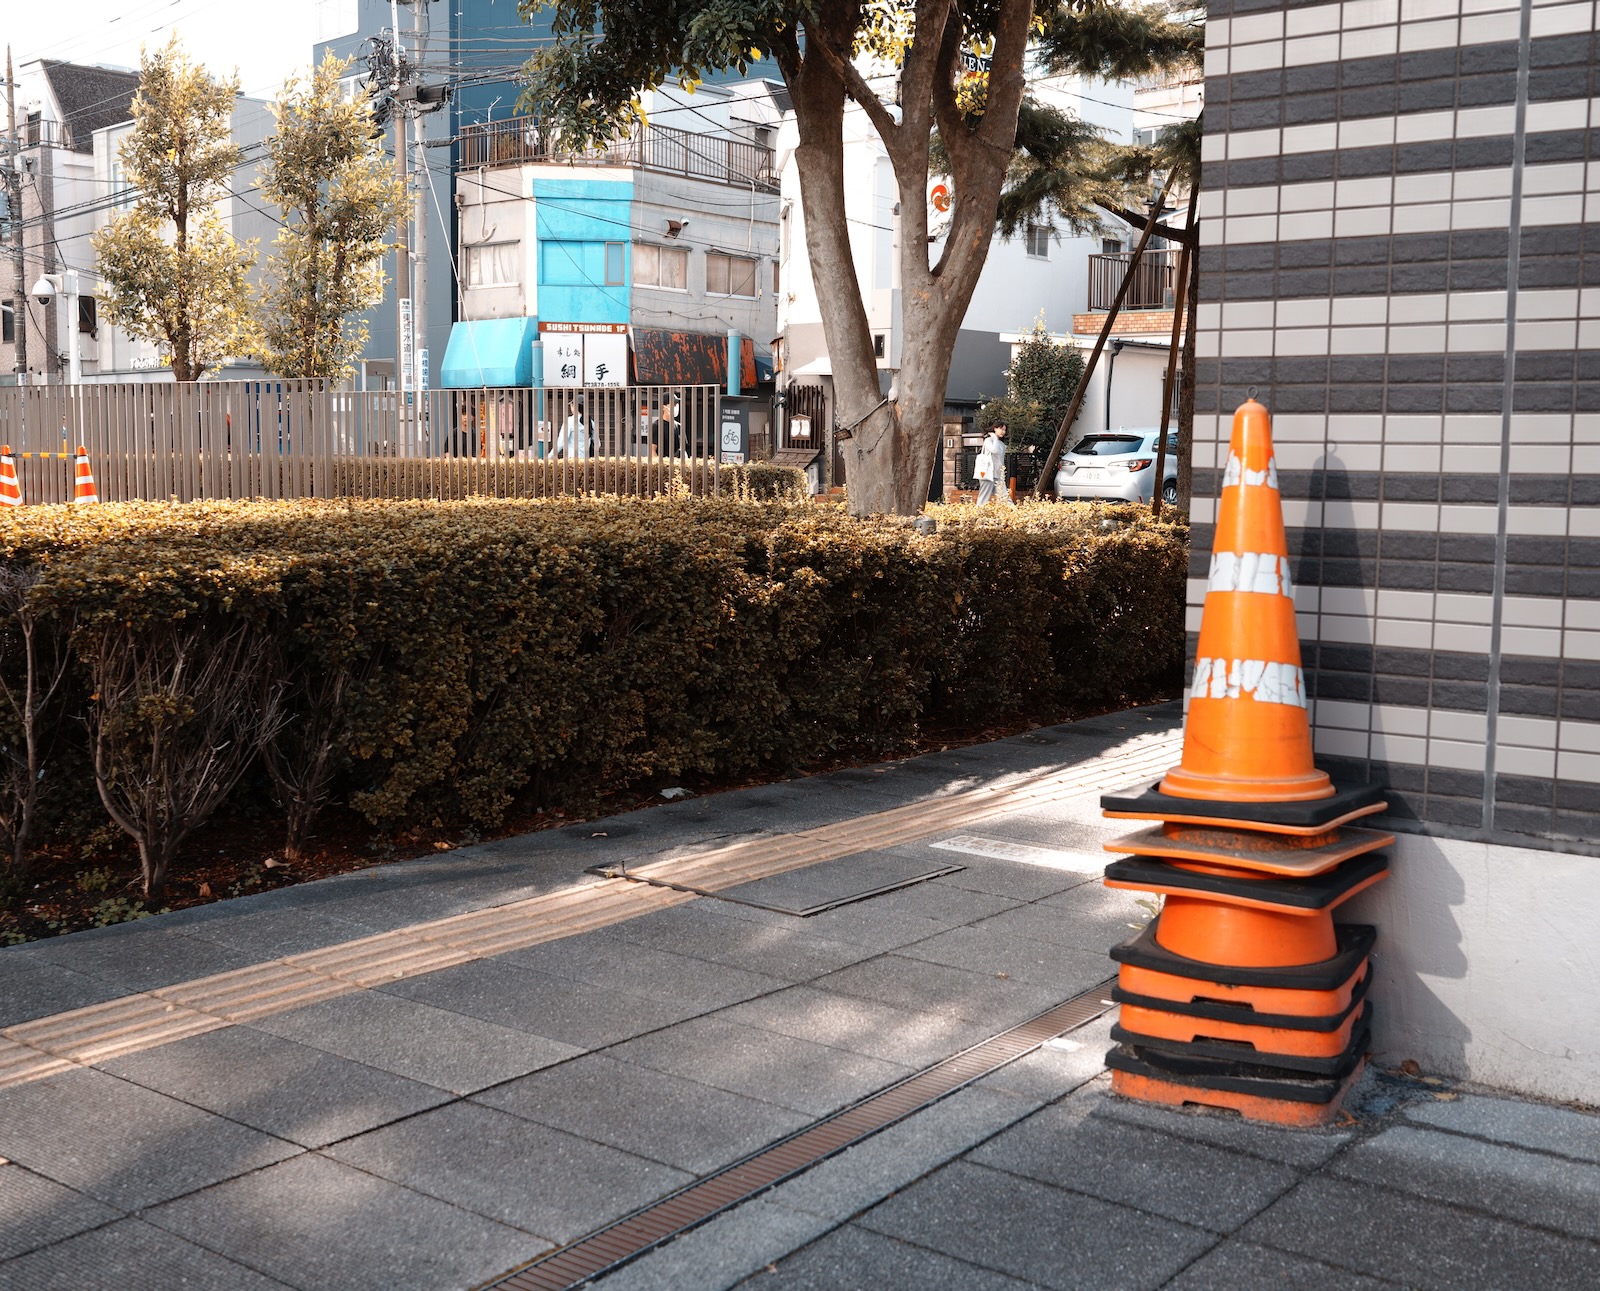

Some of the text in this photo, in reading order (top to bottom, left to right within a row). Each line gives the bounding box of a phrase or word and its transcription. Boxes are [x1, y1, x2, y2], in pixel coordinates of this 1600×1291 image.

[546, 323, 626, 333] SUSHI TSUNADE 1F
[557, 347, 581, 357] すし処
